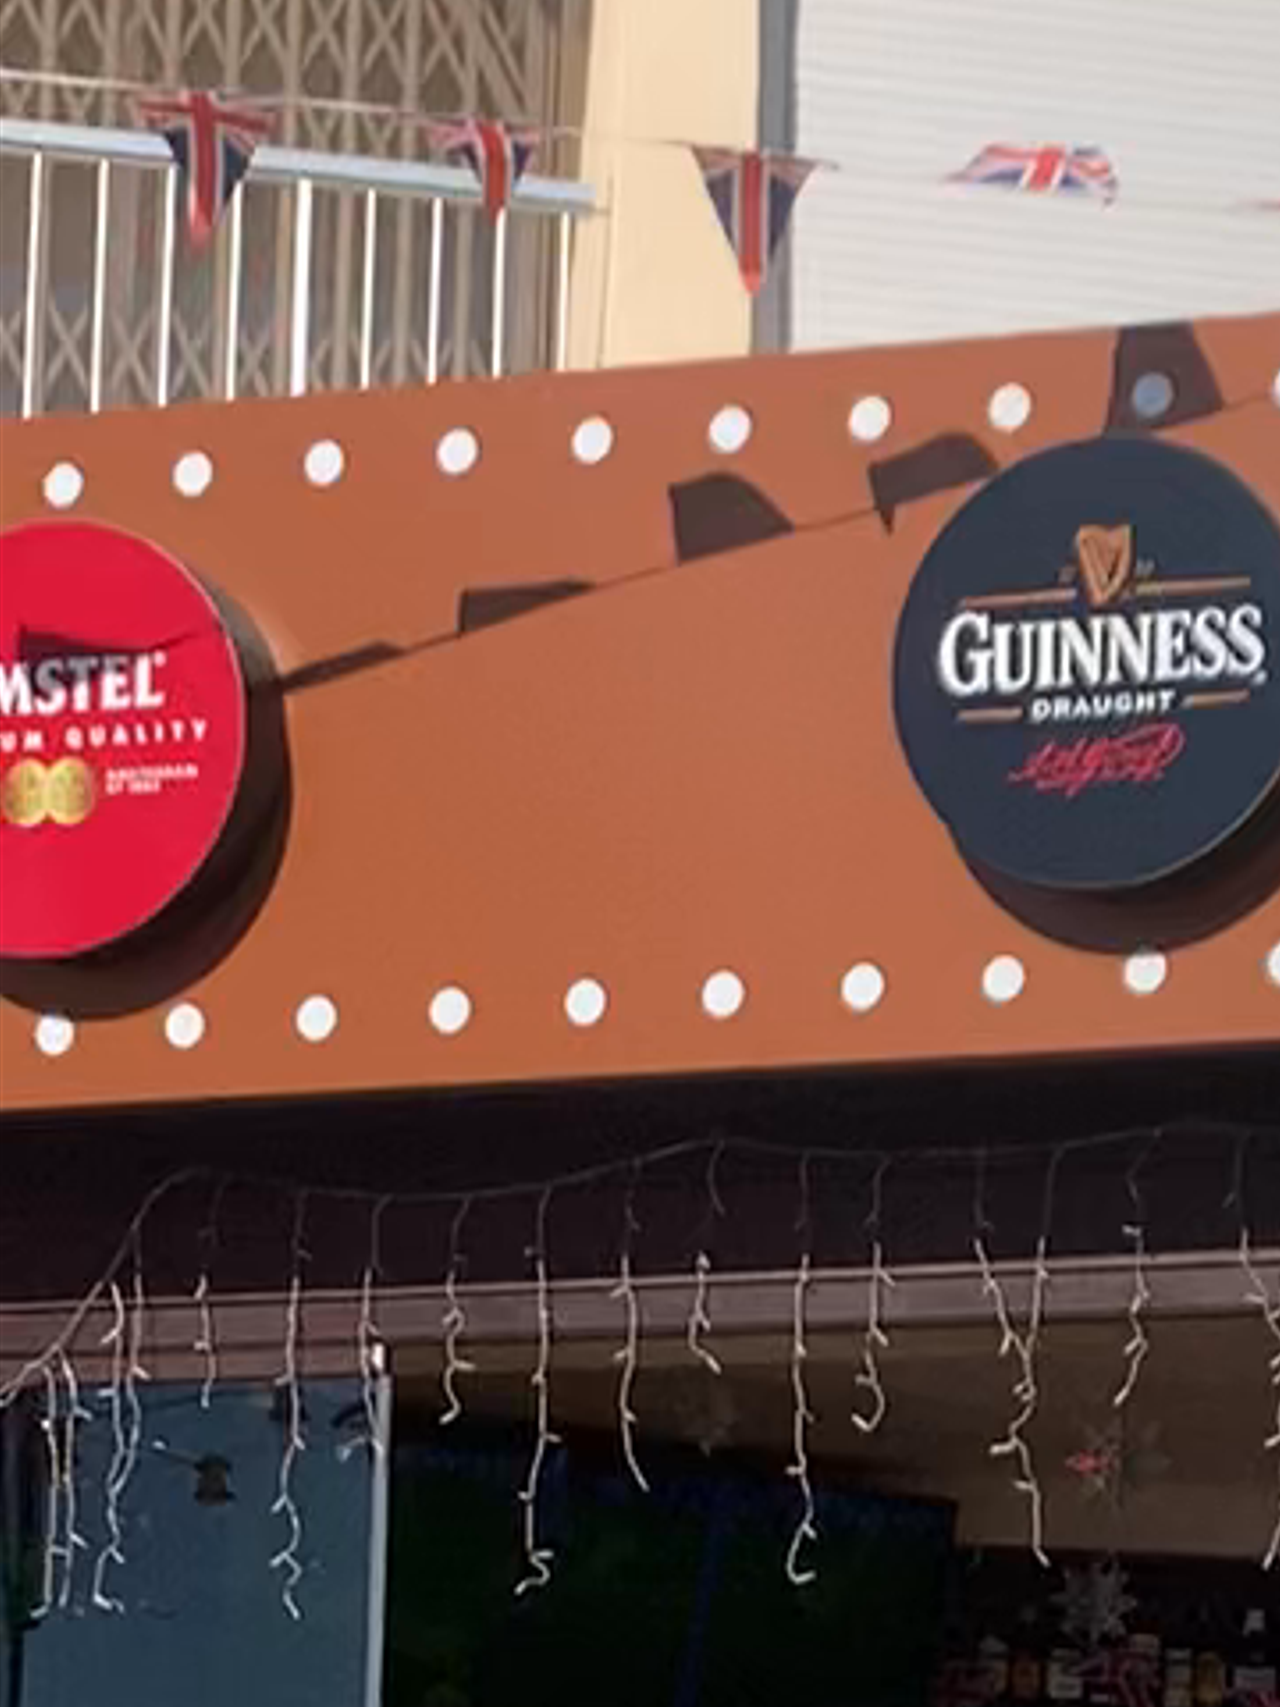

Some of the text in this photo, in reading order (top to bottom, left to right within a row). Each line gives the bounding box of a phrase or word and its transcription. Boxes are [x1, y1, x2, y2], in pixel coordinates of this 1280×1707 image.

[938, 604, 1268, 697] GUINNESS
[1031, 688, 1177, 724] DRAUGHT
[64, 718, 207, 751] QUALITY
